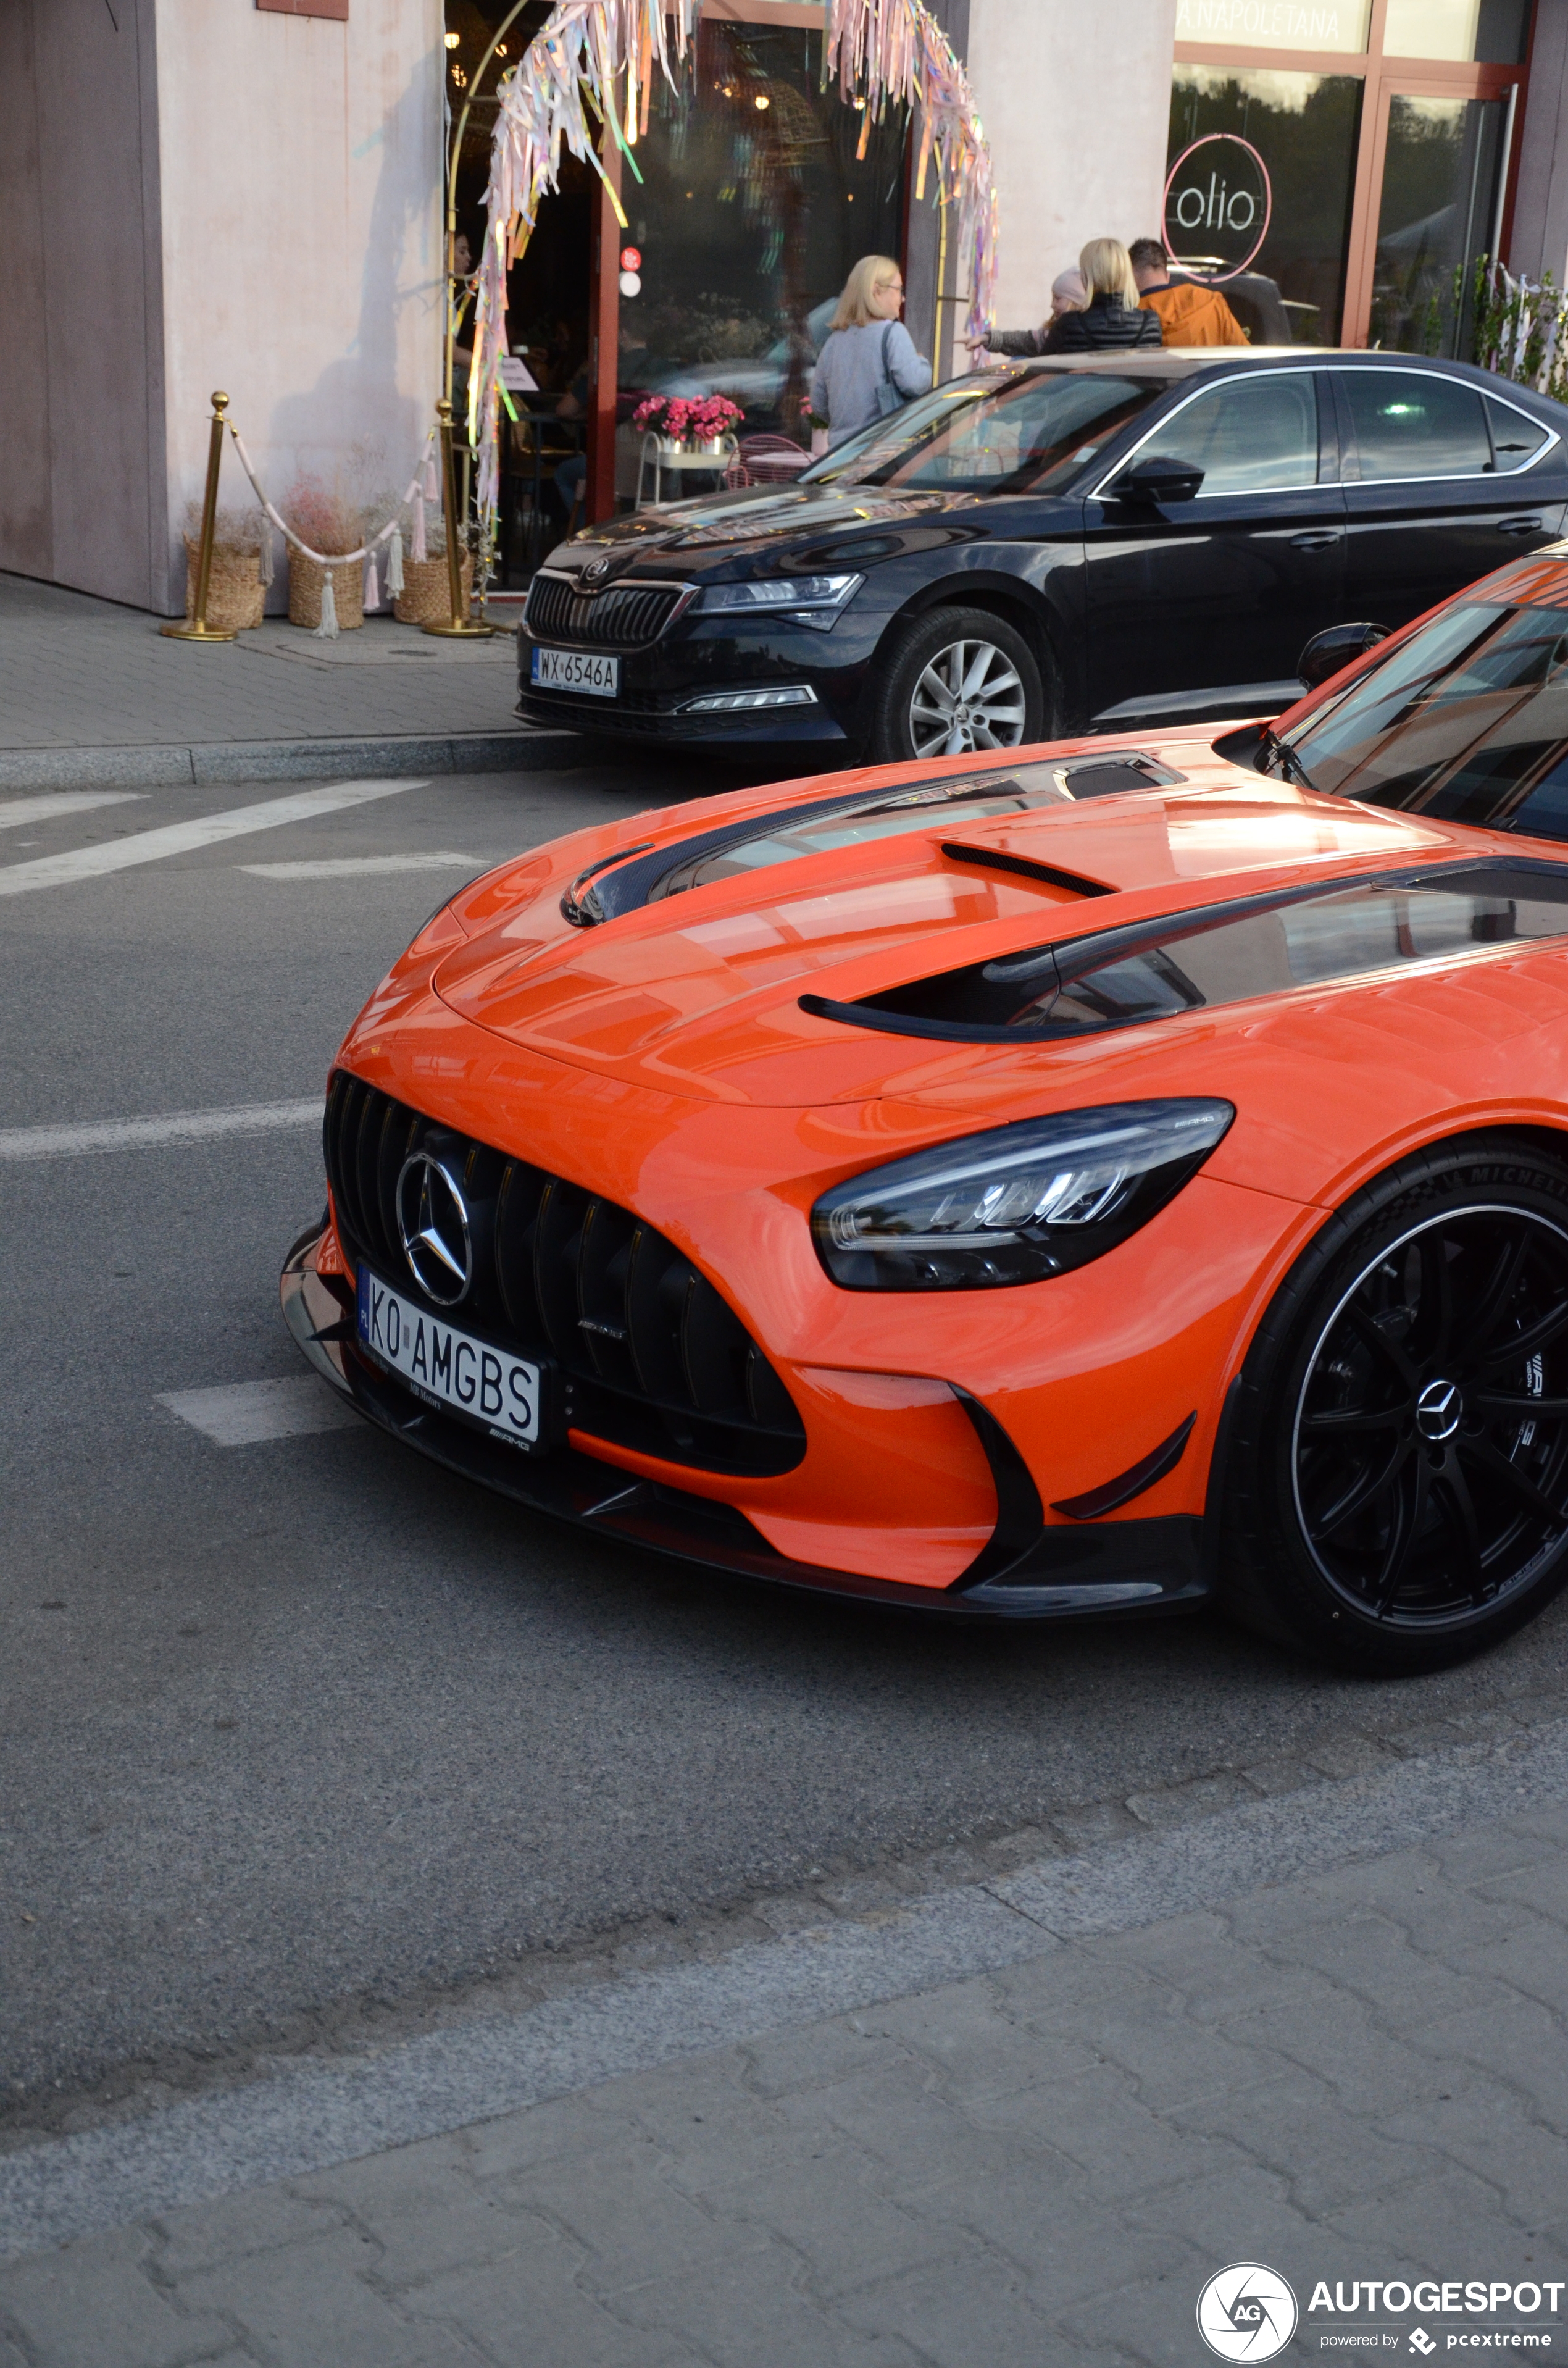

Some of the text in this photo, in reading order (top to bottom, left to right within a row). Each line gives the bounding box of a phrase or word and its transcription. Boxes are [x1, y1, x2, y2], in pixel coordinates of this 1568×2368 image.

[1177, 172, 1254, 230] olio
[541, 652, 614, 688] WX 6546A
[1471, 1166, 1568, 1199] MICHELI
[361, 1311, 368, 1328] PL
[411, 1317, 532, 1429] AMGBS
[409, 1382, 441, 1410] MB Motors
